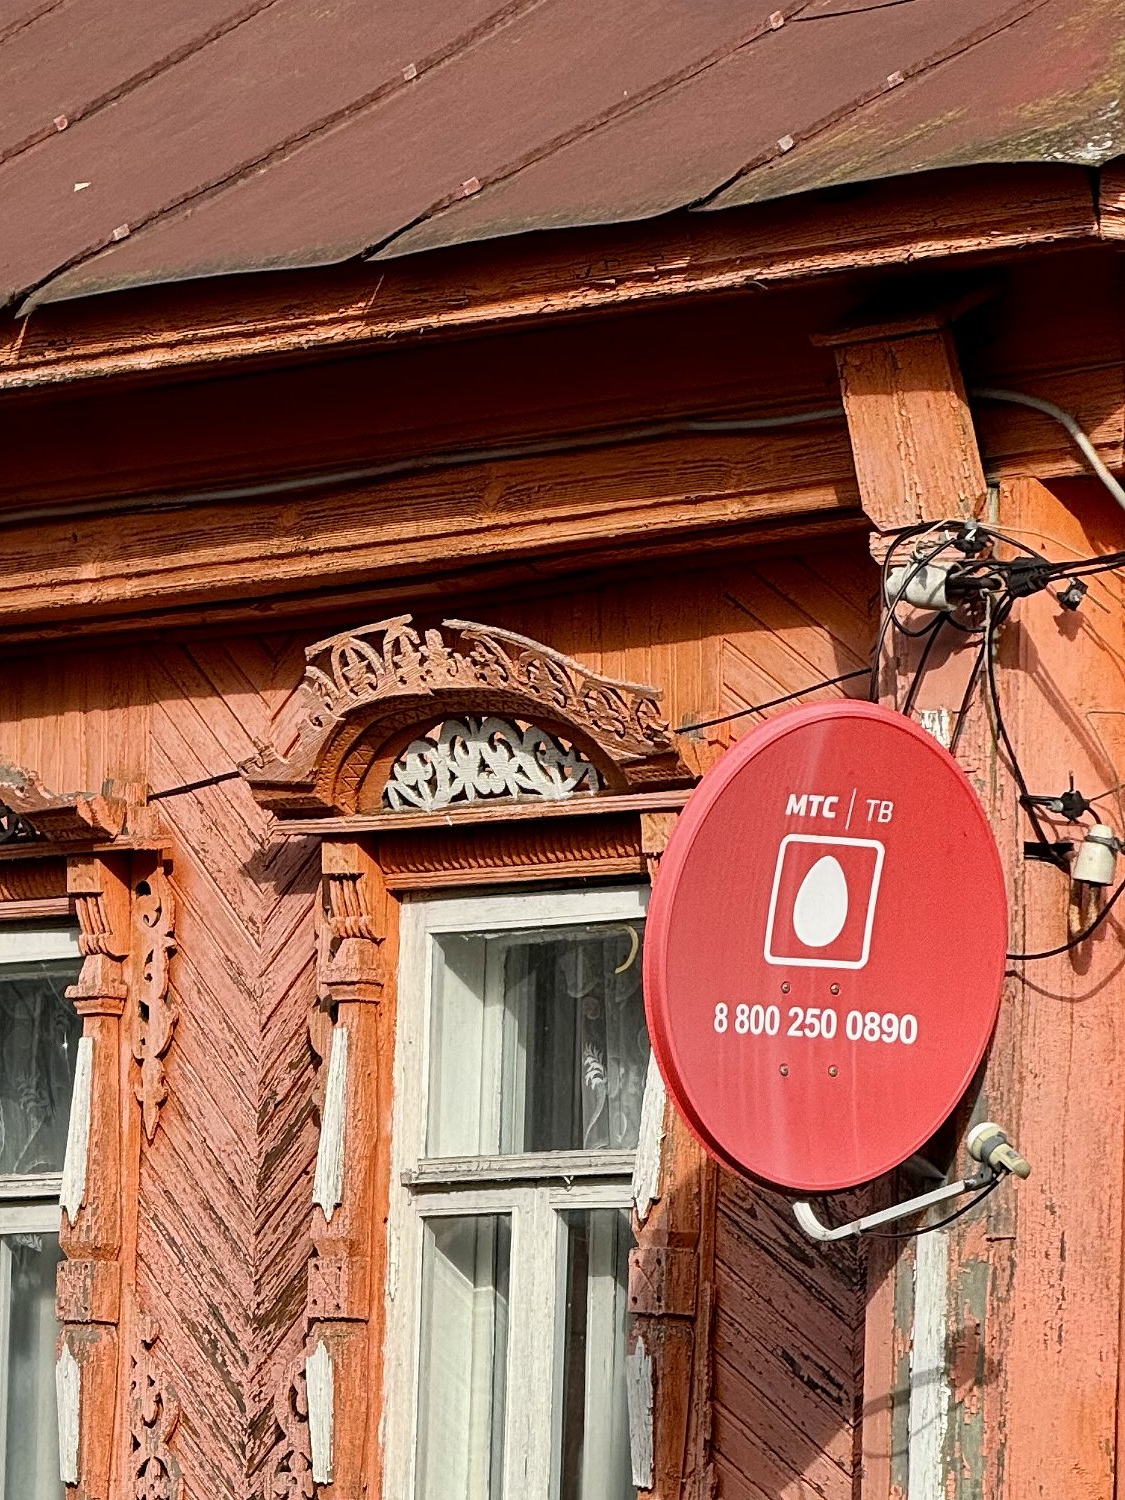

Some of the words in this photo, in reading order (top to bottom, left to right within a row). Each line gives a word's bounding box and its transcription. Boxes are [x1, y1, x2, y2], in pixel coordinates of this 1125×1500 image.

[785, 793, 839, 819] МТС
[865, 799, 894, 823] ТВ
[713, 1002, 729, 1034] 8
[734, 1003, 781, 1036] 800
[786, 1006, 838, 1040] 250
[845, 1010, 918, 1045] 0890
